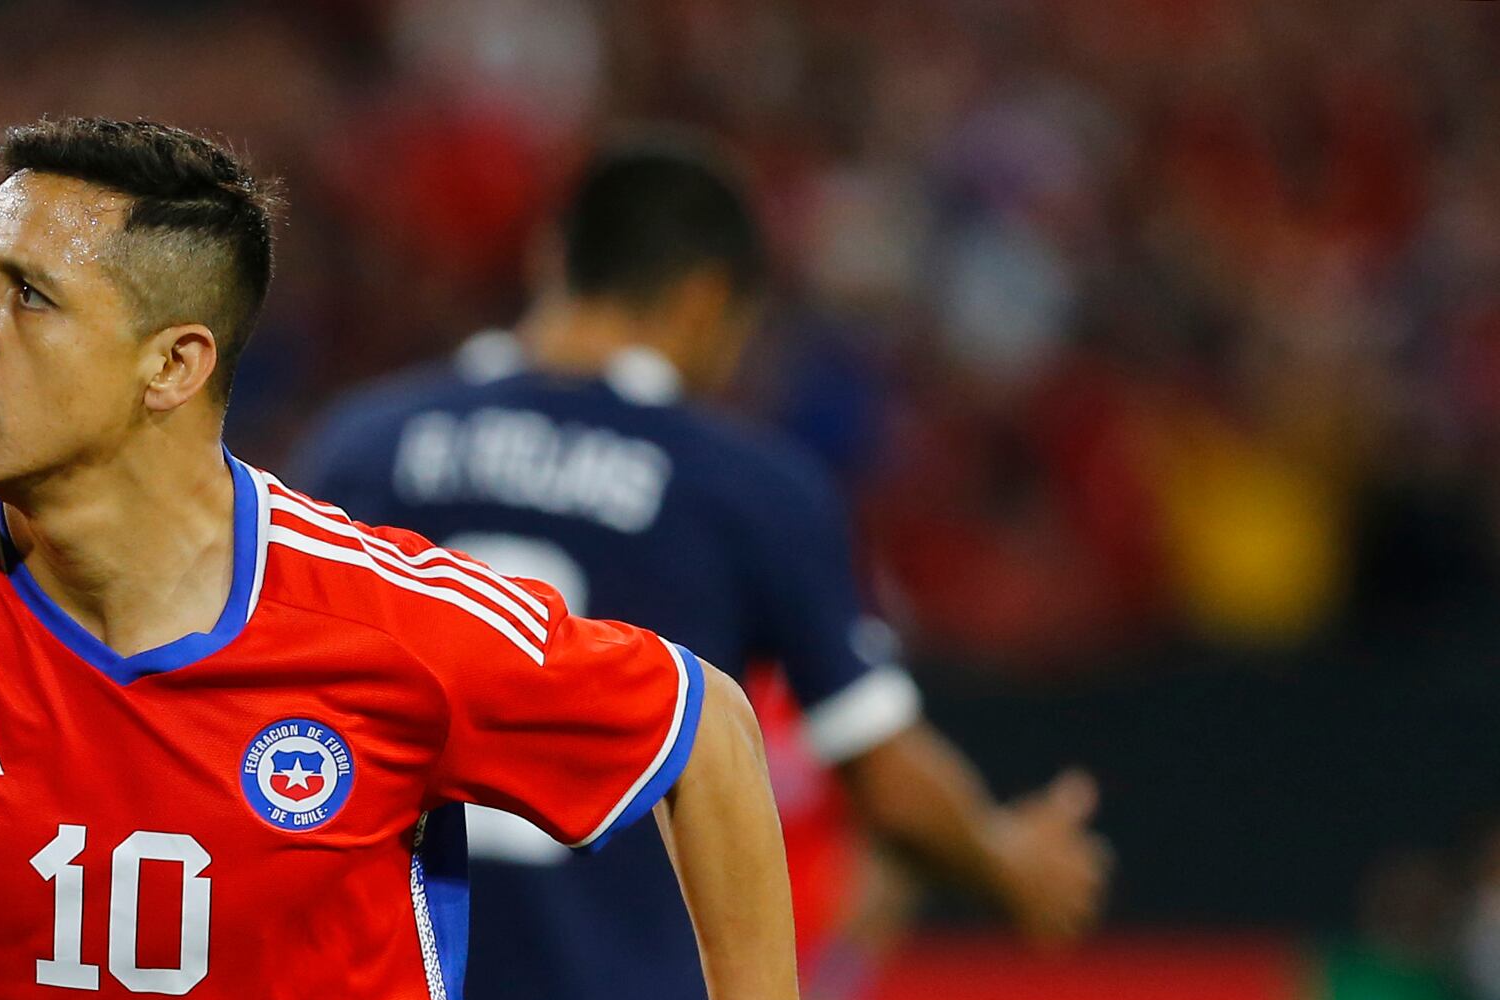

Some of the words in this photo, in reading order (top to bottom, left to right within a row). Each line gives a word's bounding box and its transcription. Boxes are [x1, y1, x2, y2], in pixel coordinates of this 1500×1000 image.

[244, 724, 299, 774] FEDERACION
[306, 726, 323, 740] DE
[324, 737, 350, 776] FUTBOL
[270, 810, 287, 823] DE
[293, 808, 326, 825] CHILE
[29, 823, 212, 995] 10
